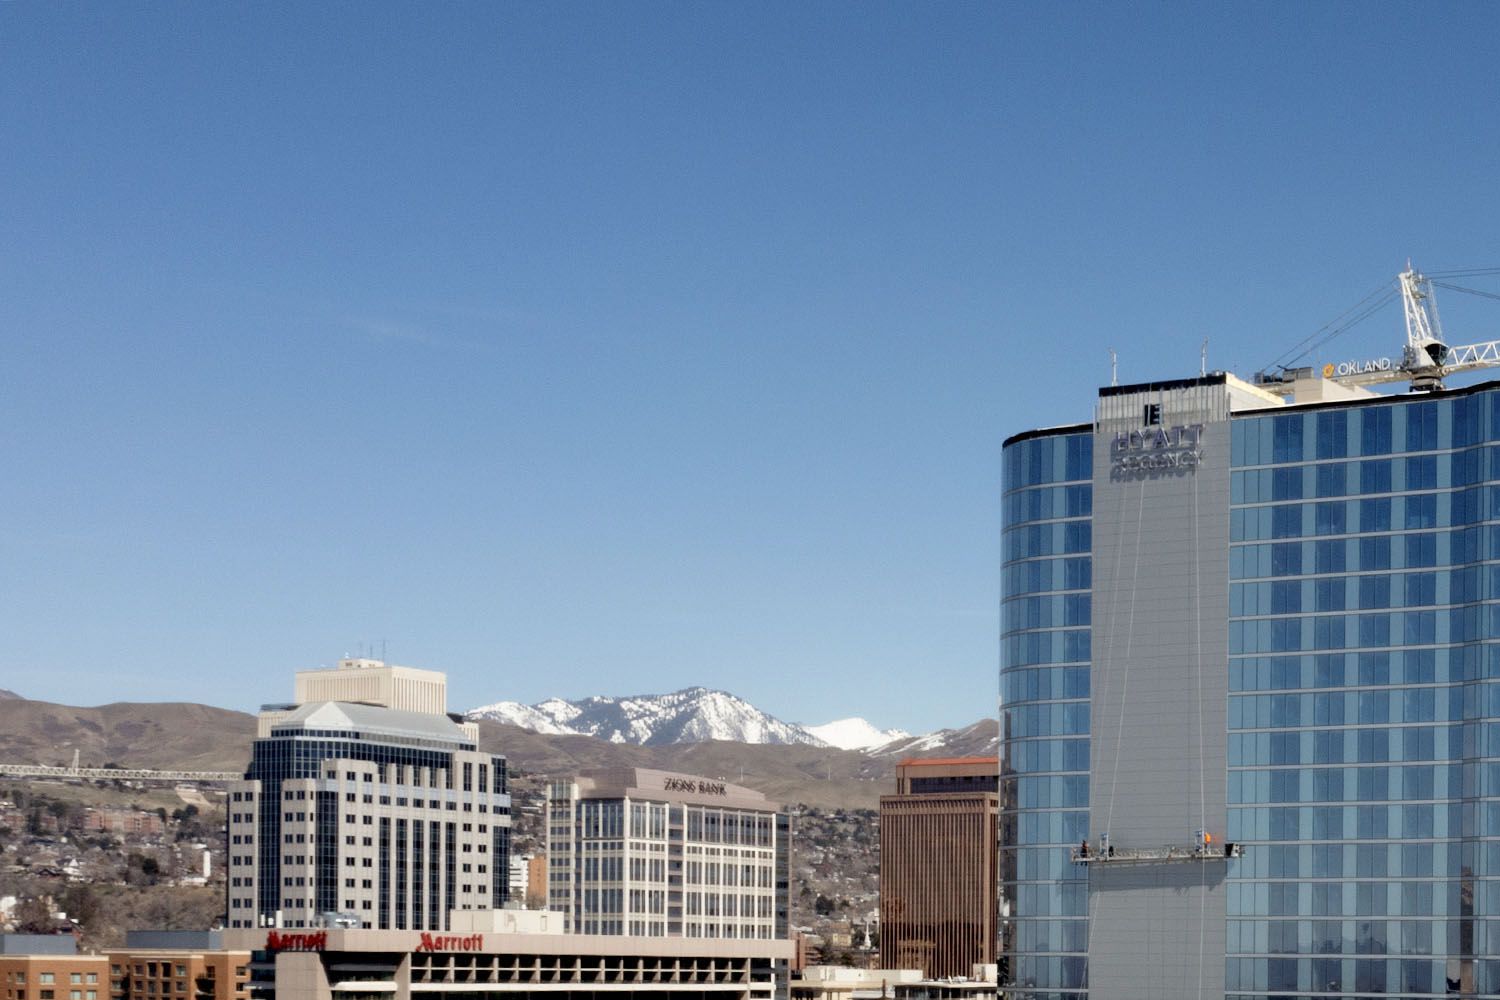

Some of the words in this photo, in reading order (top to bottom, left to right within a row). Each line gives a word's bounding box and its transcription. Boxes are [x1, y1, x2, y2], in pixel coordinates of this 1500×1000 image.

[1338, 357, 1391, 375] OKLAND
[1116, 424, 1205, 450] HYATT
[264, 931, 328, 951] Marriott
[416, 932, 484, 952] Marriott
